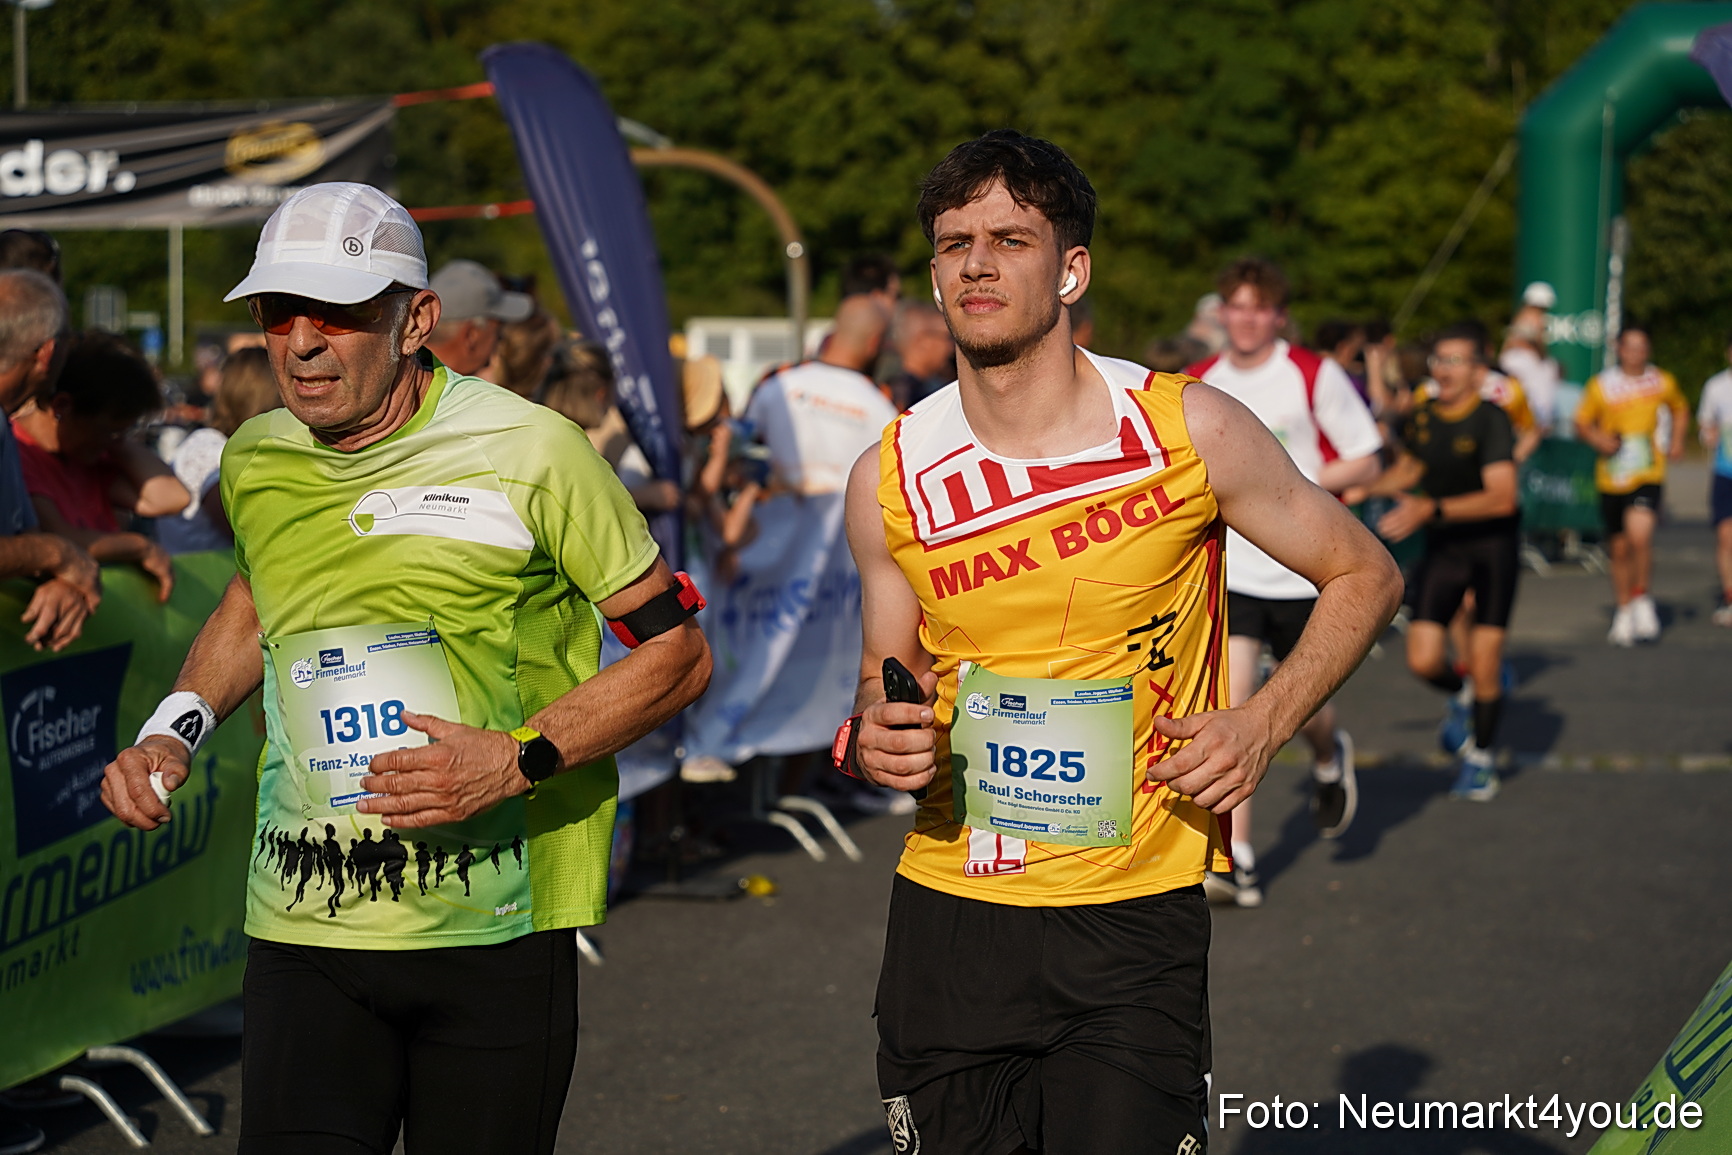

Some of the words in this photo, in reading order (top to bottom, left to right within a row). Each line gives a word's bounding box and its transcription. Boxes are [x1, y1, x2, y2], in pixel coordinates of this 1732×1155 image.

[423, 493, 470, 504] Klinikum
[418, 502, 468, 515] Neumarkt
[928, 537, 1042, 600] MAX
[1050, 485, 1186, 560] BÖGL
[315, 661, 366, 679] Firmenlauf
[334, 670, 366, 682] neumarkt
[320, 699, 408, 744] 1318
[992, 708, 1047, 720] Firmenlauf
[28, 694, 101, 754] Fischer
[986, 742, 1086, 783] 1825
[979, 779, 1010, 798] Raul
[1014, 787, 1103, 806] Schorscher
[992, 819, 1046, 832] firmenlauf.bayern
